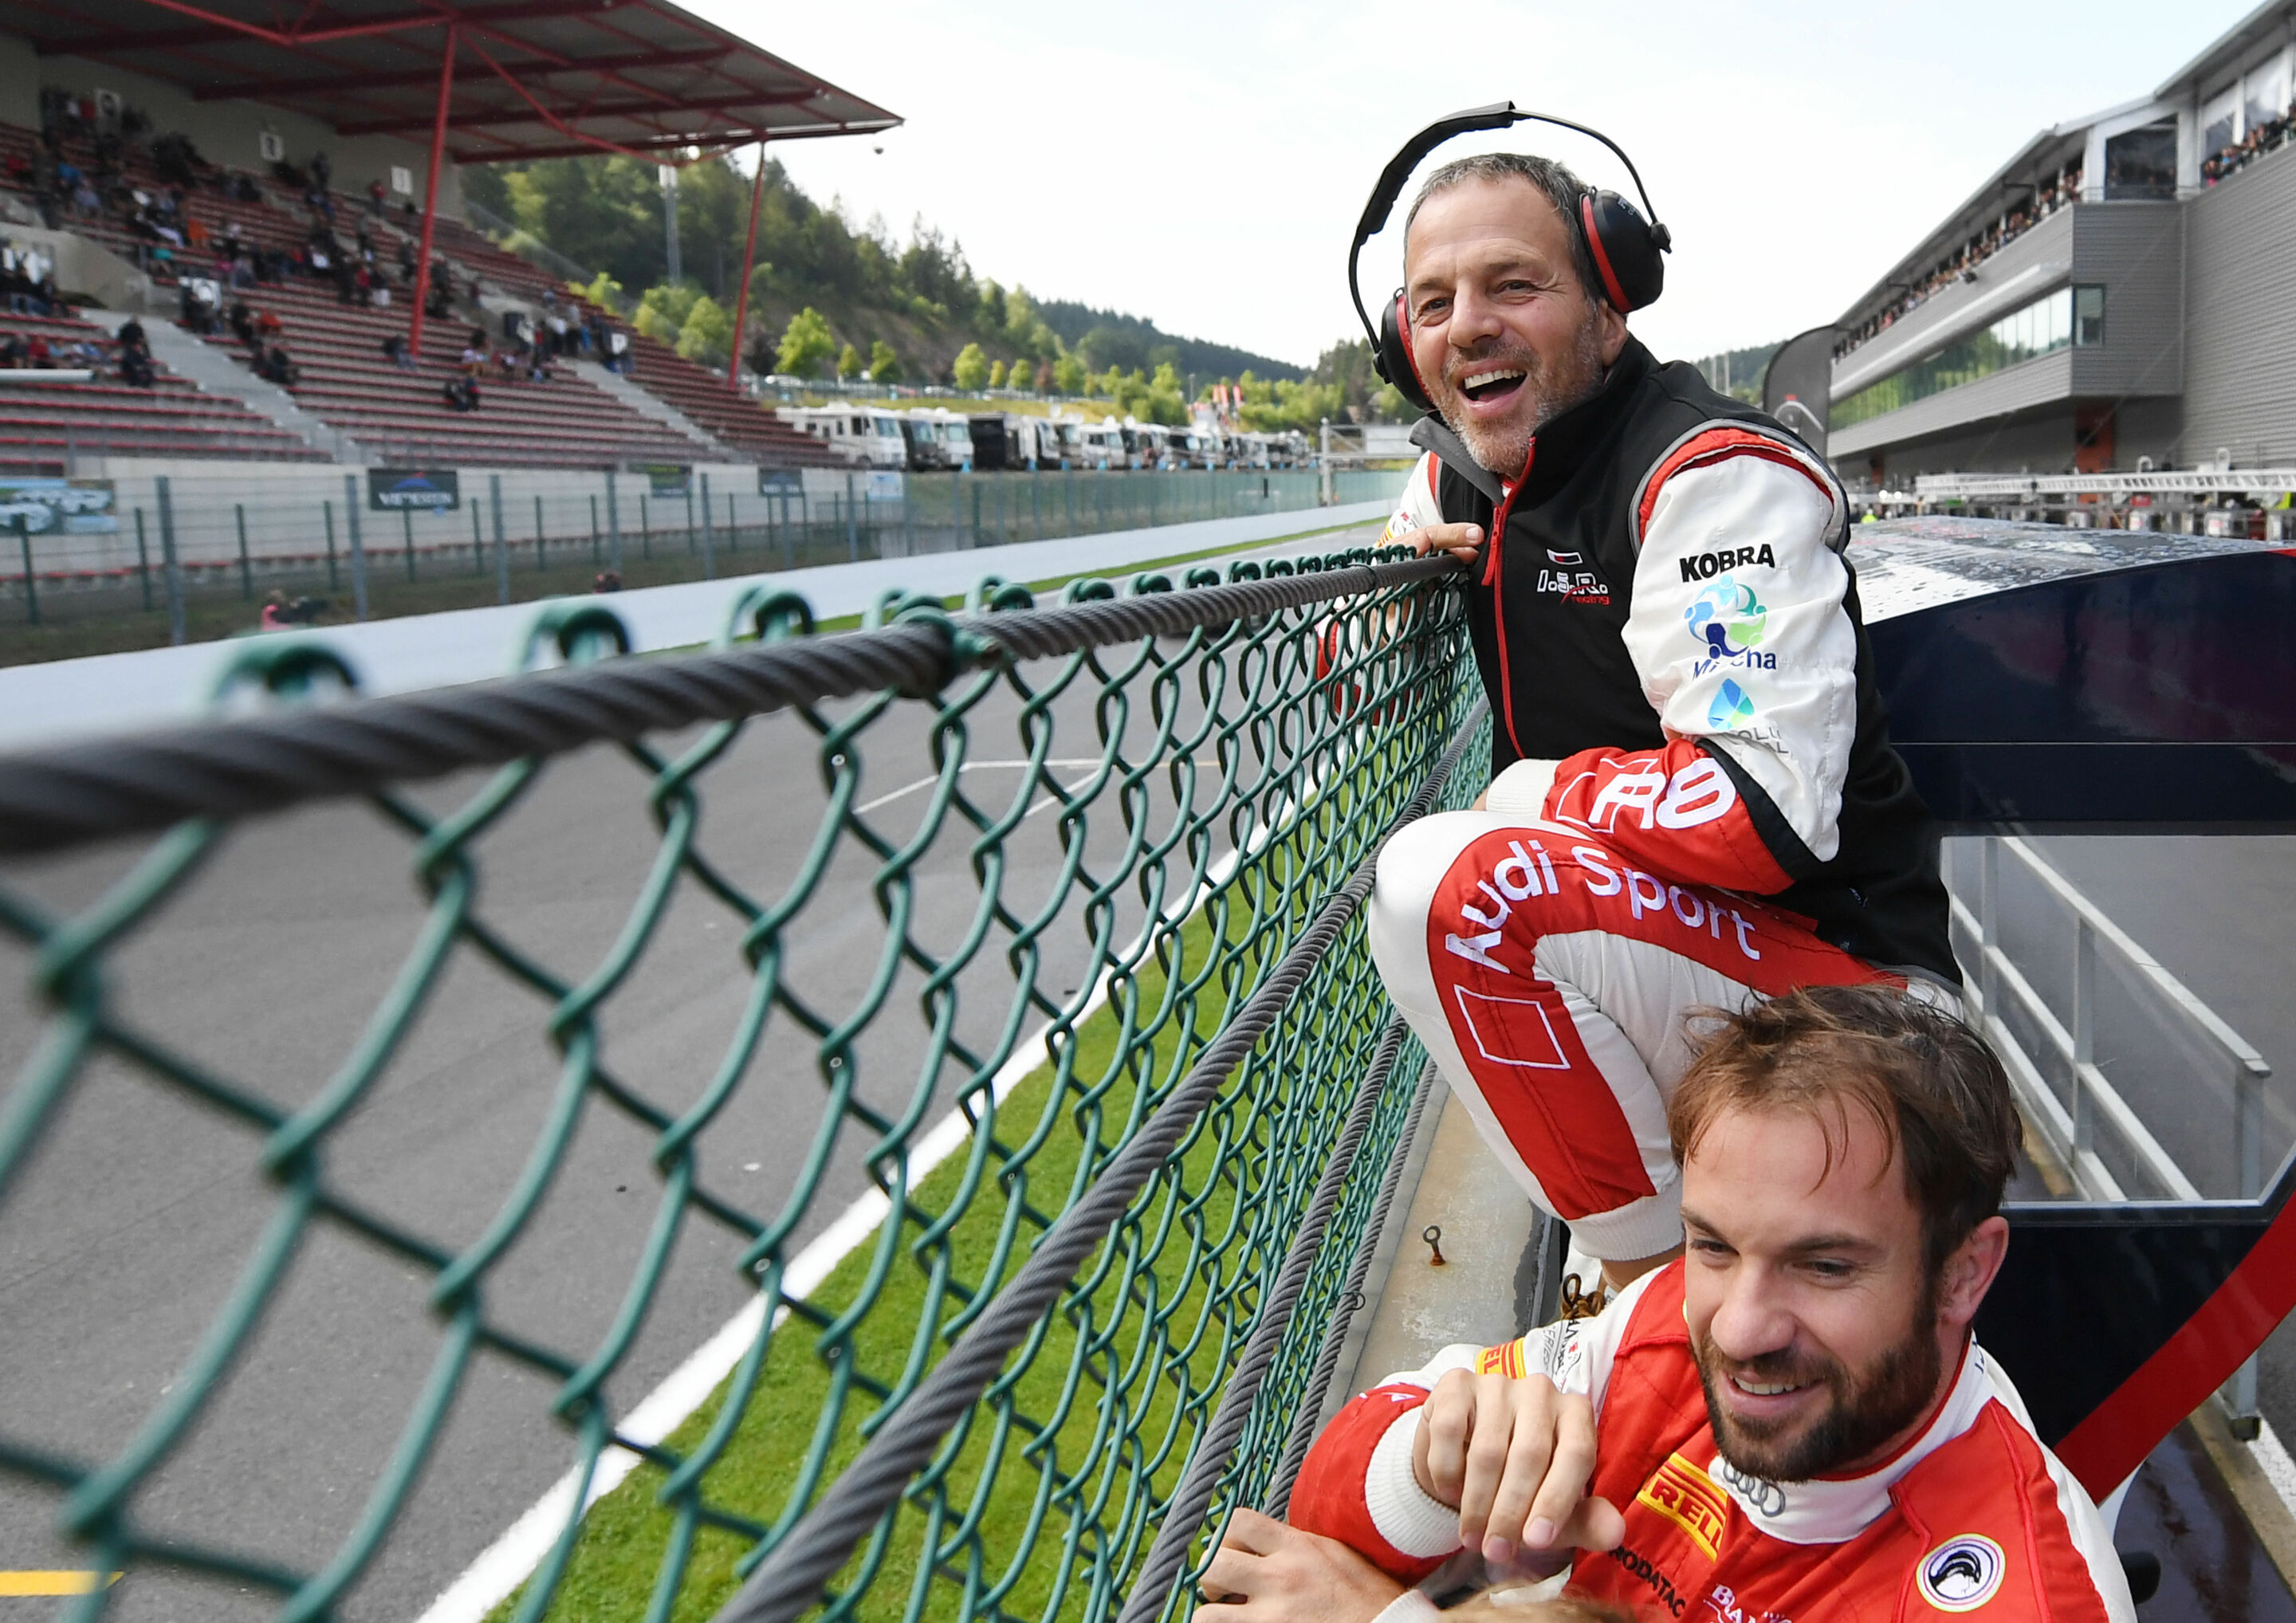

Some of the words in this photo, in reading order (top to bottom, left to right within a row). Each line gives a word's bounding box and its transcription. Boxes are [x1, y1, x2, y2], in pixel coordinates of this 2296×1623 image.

[1679, 544, 1775, 583] KOBRA
[1588, 758, 1736, 830] R8
[1445, 839, 1559, 974] Audi
[1571, 845, 1760, 961] Sport
